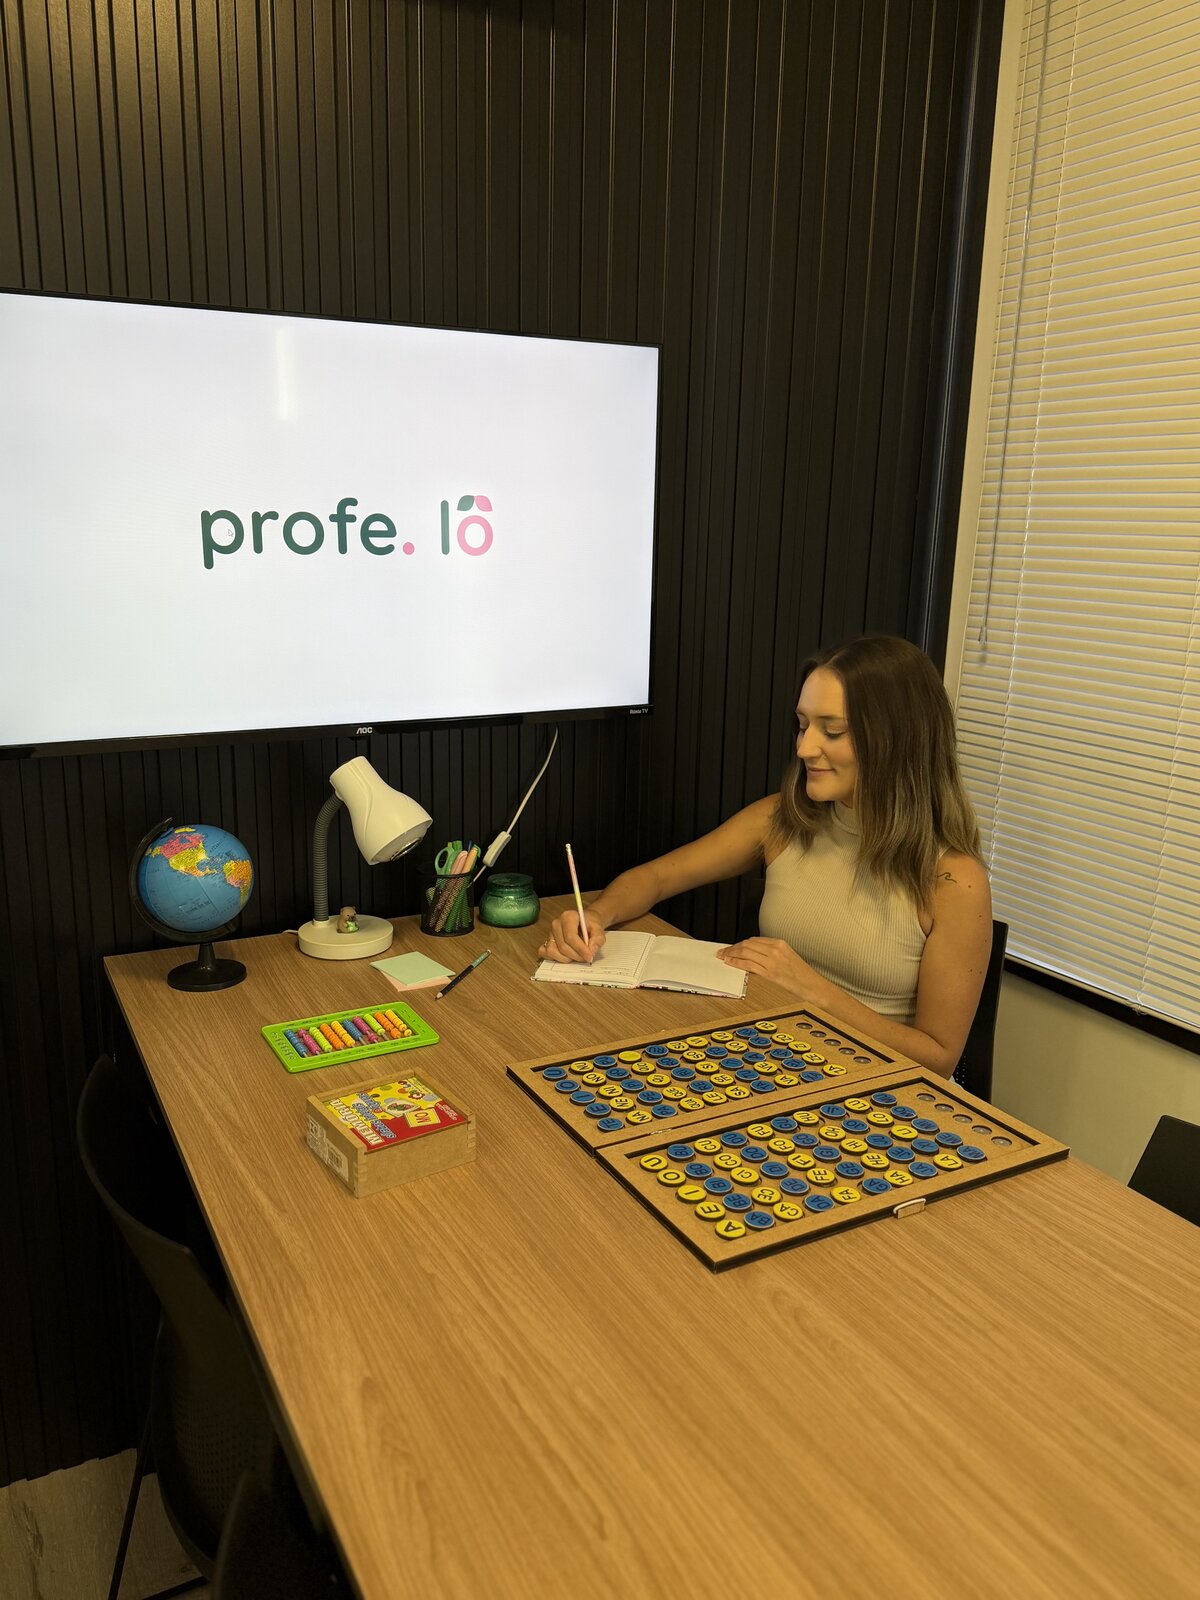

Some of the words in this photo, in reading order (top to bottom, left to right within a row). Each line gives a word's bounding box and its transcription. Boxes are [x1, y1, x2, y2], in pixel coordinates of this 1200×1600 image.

[200, 497, 415, 569] profe.
[356, 726, 373, 735] AOC
[848, 1100, 867, 1109] LU
[329, 1098, 385, 1146] MEMÓRIA
[873, 1113, 889, 1122] LO
[775, 1119, 792, 1129] GU
[846, 1120, 865, 1129] JO
[751, 1126, 770, 1136] FU
[724, 1133, 745, 1144] DU
[796, 1134, 815, 1144] GO
[698, 1140, 717, 1150] CU
[773, 1140, 792, 1150] FO
[846, 1140, 862, 1149] HI
[673, 1146, 689, 1156] BU
[745, 1147, 765, 1159] DO
[819, 1148, 834, 1158] GI
[891, 1148, 911, 1157] JE
[644, 1157, 662, 1167] U
[719, 1155, 738, 1166] CO
[792, 1155, 811, 1166] FI
[866, 1155, 885, 1165] HE
[940, 1155, 958, 1166] LA
[689, 1164, 709, 1175] BO
[766, 1164, 783, 1173] DI
[839, 1162, 860, 1175] GE
[915, 1163, 934, 1173] JA
[663, 1172, 680, 1181] O
[737, 1169, 752, 1179] CI
[812, 1170, 829, 1181] FE
[890, 1171, 910, 1184] HA
[709, 1180, 726, 1189] BI
[783, 1178, 805, 1191] DE
[868, 1179, 888, 1191] GA
[757, 1189, 775, 1201] CE
[838, 1189, 857, 1200] FA
[726, 1194, 748, 1208] BE
[810, 1195, 831, 1209] DA
[700, 1204, 720, 1214] E
[779, 1203, 799, 1216] CA
[750, 1212, 771, 1226] BA
[724, 1221, 742, 1233] A
